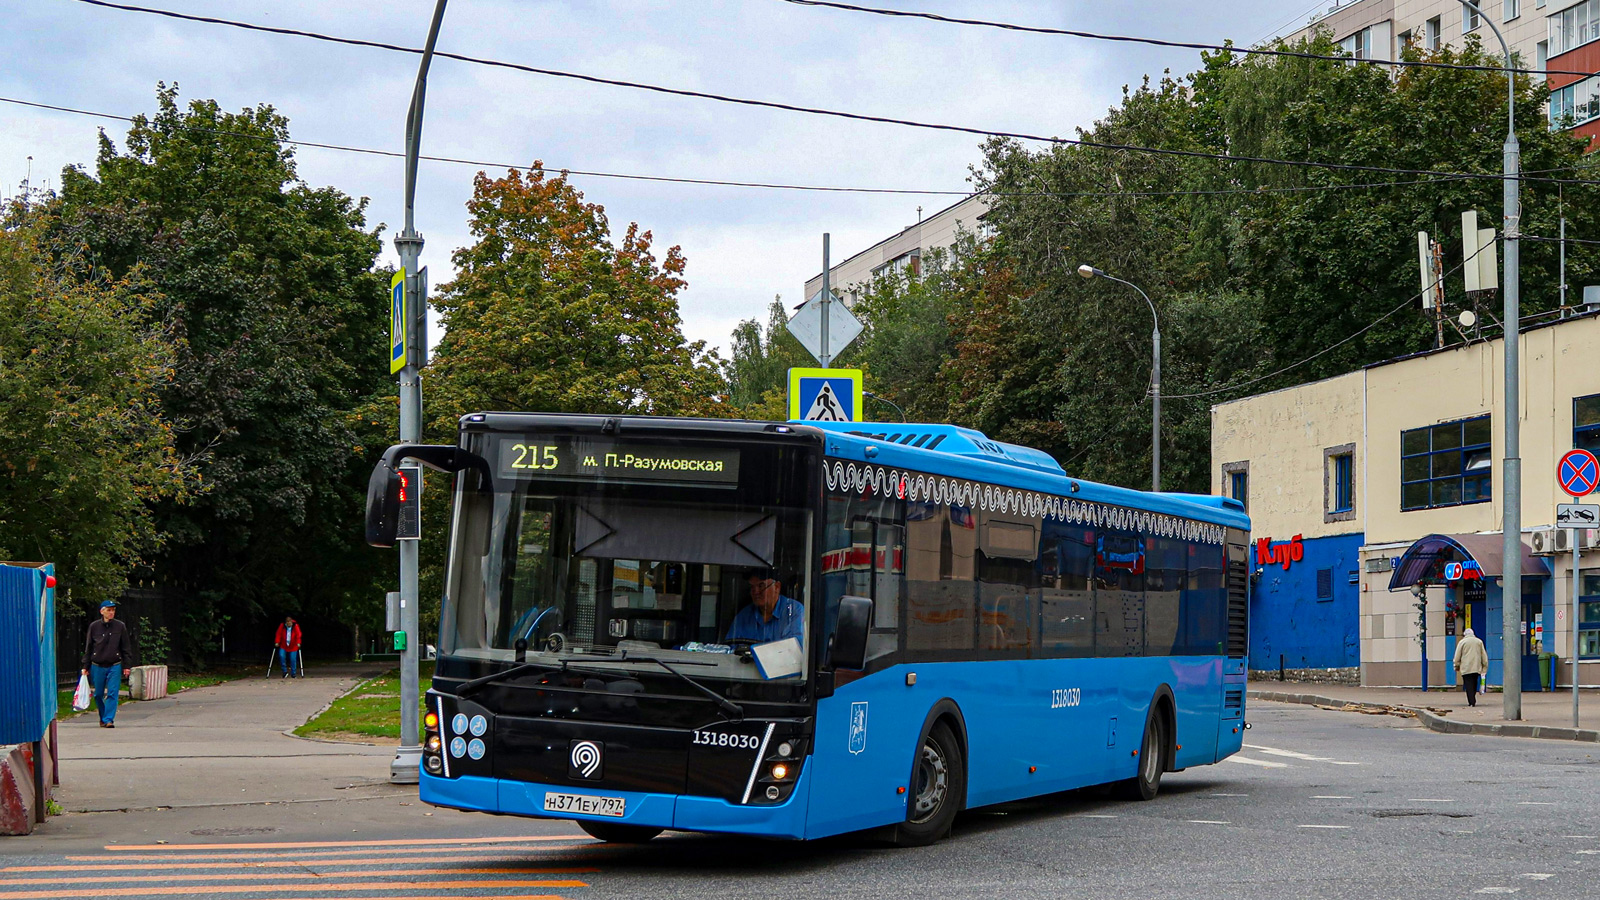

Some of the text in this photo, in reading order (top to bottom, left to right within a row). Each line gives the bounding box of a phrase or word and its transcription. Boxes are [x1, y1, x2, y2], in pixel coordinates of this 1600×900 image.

[511, 443, 723, 472] 215 м. П.-Разумовская
[1257, 533, 1303, 570] Клуб
[1051, 687, 1081, 709] 1318030
[692, 730, 760, 749] 1318030
[601, 799, 622, 811] 797
